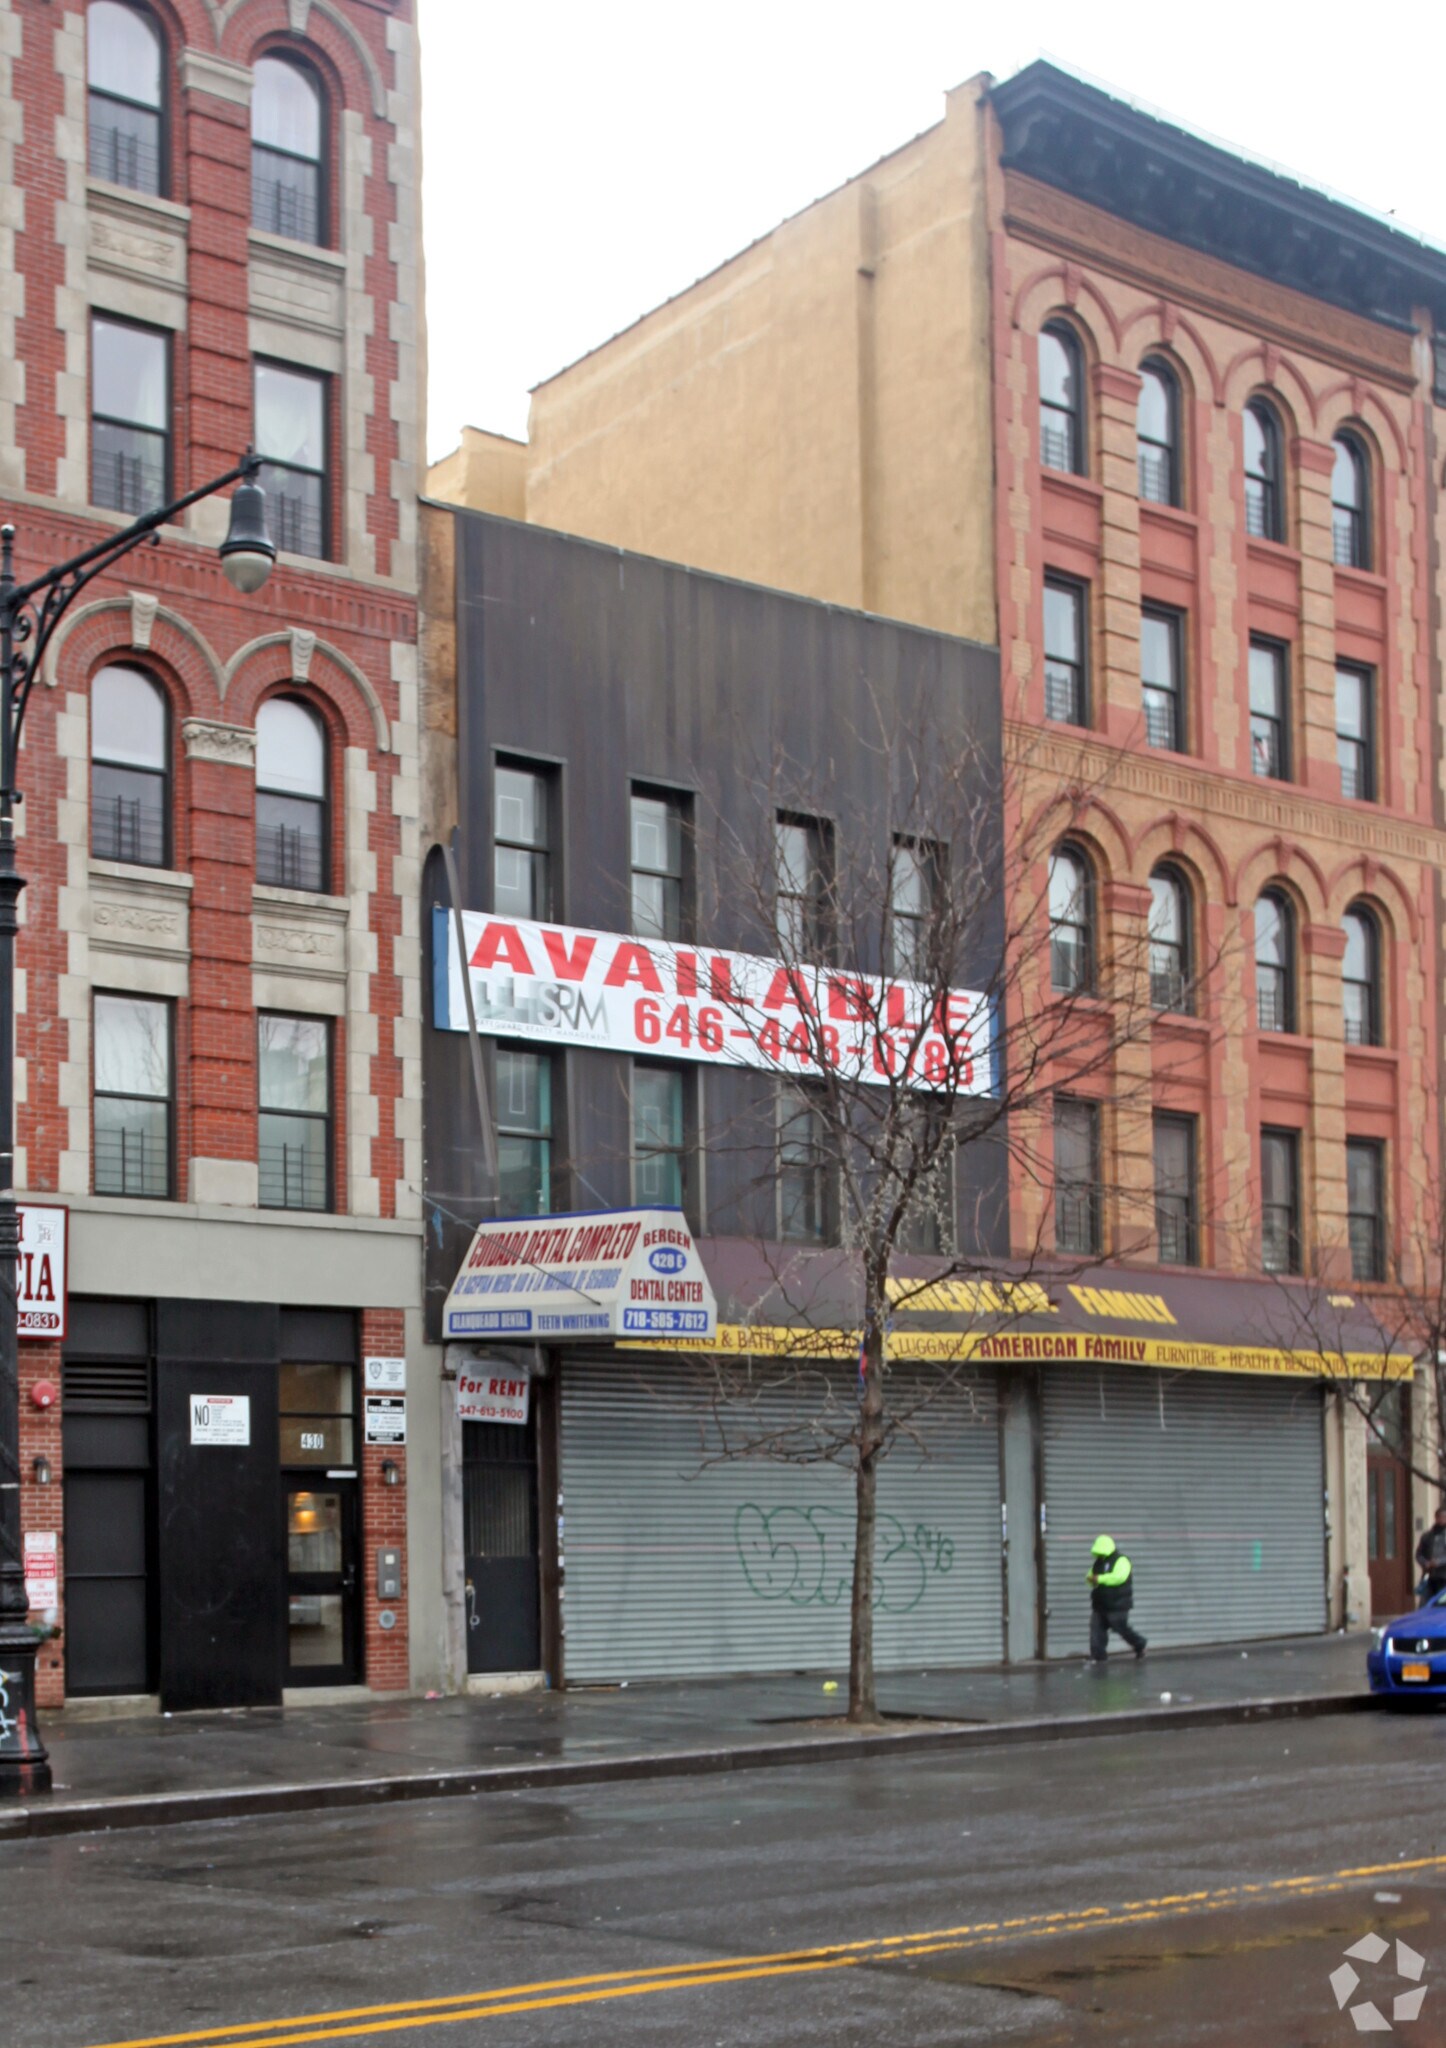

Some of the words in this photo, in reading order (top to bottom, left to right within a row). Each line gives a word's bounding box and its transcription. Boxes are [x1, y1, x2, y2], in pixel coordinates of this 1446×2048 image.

[468, 921, 972, 1038] AVAILABLE
[468, 1231, 530, 1269] CUIDADO
[520, 1227, 574, 1265] DENTAL
[567, 1221, 642, 1263] COMPLETO
[643, 1229, 691, 1250] BERGEN
[676, 1254, 683, 1269] E
[631, 1279, 665, 1301] DENTAL
[667, 1280, 703, 1303] CENTER
[1067, 1284, 1178, 1324] FAMILY
[538, 1314, 560, 1330] TEETH
[562, 1313, 609, 1330] WHITENING
[721, 1330, 733, 1348] &
[899, 1337, 965, 1355] LUGGAGE
[980, 1337, 1077, 1359] AMERICAN
[1085, 1336, 1146, 1361] FAMILY
[1156, 1346, 1218, 1367] FURNITURE
[1229, 1351, 1271, 1370] HEALTH
[489, 1378, 527, 1397] RENT
[194, 1405, 210, 1426] NO
[459, 1405, 524, 1419] 347-613-5100
[302, 1433, 322, 1449] 430
